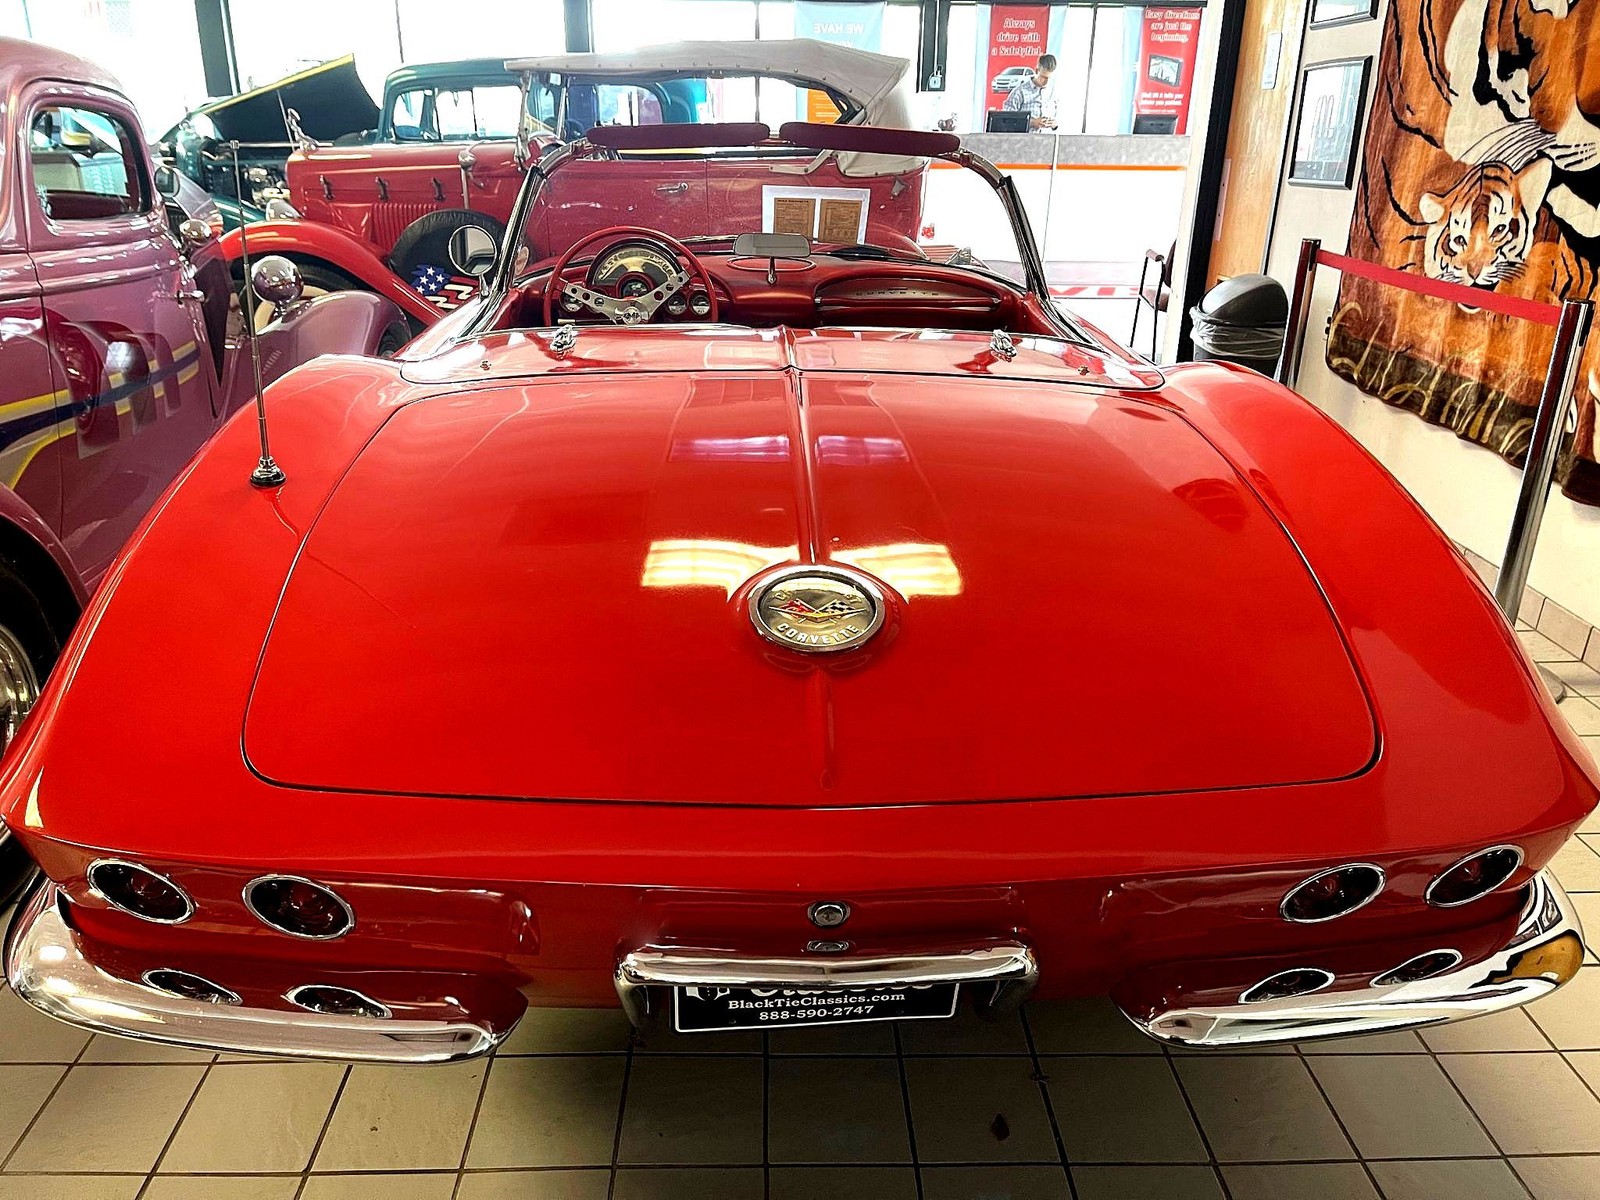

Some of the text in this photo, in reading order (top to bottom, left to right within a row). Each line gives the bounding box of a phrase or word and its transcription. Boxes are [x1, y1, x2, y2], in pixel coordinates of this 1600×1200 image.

[1145, 10, 1200, 20] Easy directions
[1003, 18, 1036, 30] Always
[1151, 21, 1192, 31] are just the
[996, 32, 1040, 42] drive with
[1151, 32, 1188, 43] beginning.
[991, 48, 998, 56] a
[777, 622, 860, 644] CORVETTE
[728, 993, 905, 1010] BlackTieClassics.com
[759, 1005, 875, 1020] 888-590-2747
